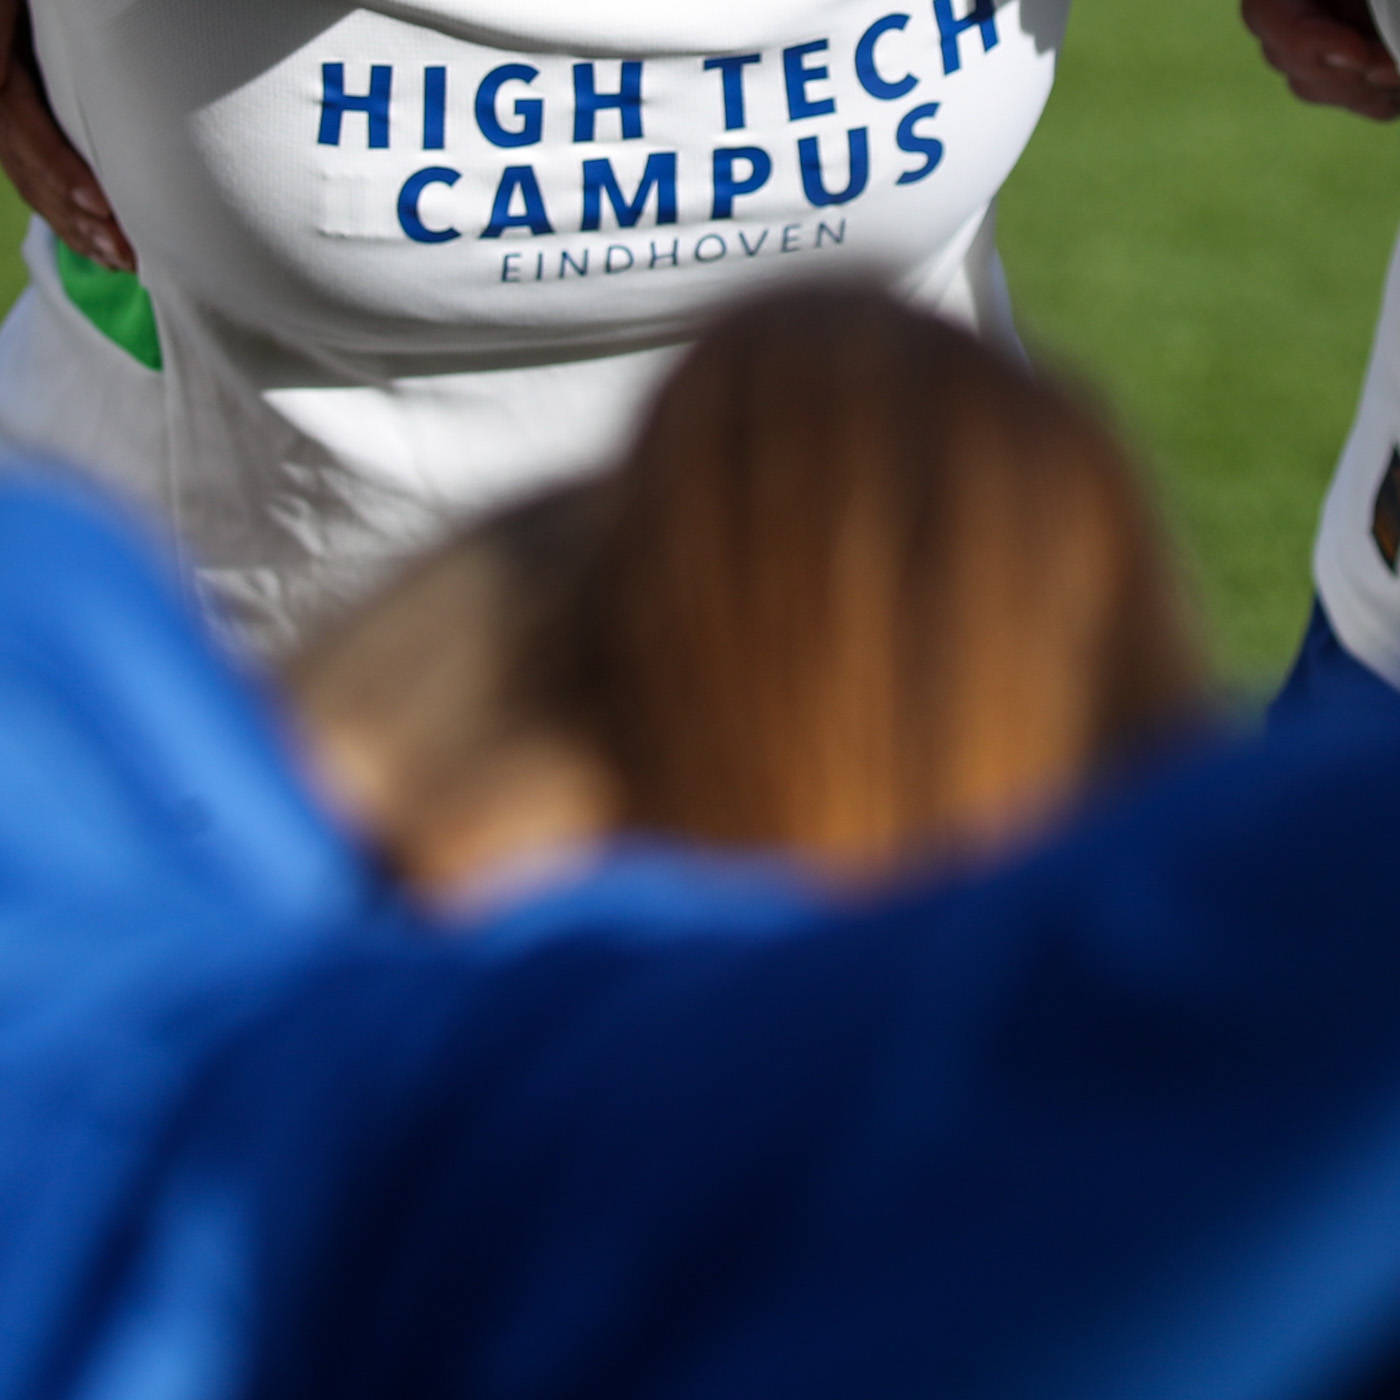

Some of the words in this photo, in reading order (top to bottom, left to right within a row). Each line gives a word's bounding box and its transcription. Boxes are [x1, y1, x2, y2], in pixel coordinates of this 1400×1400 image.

[316, 60, 647, 151] HIGH
[397, 101, 945, 245] CAMPUS
[499, 217, 847, 284] EINDHOVEN
